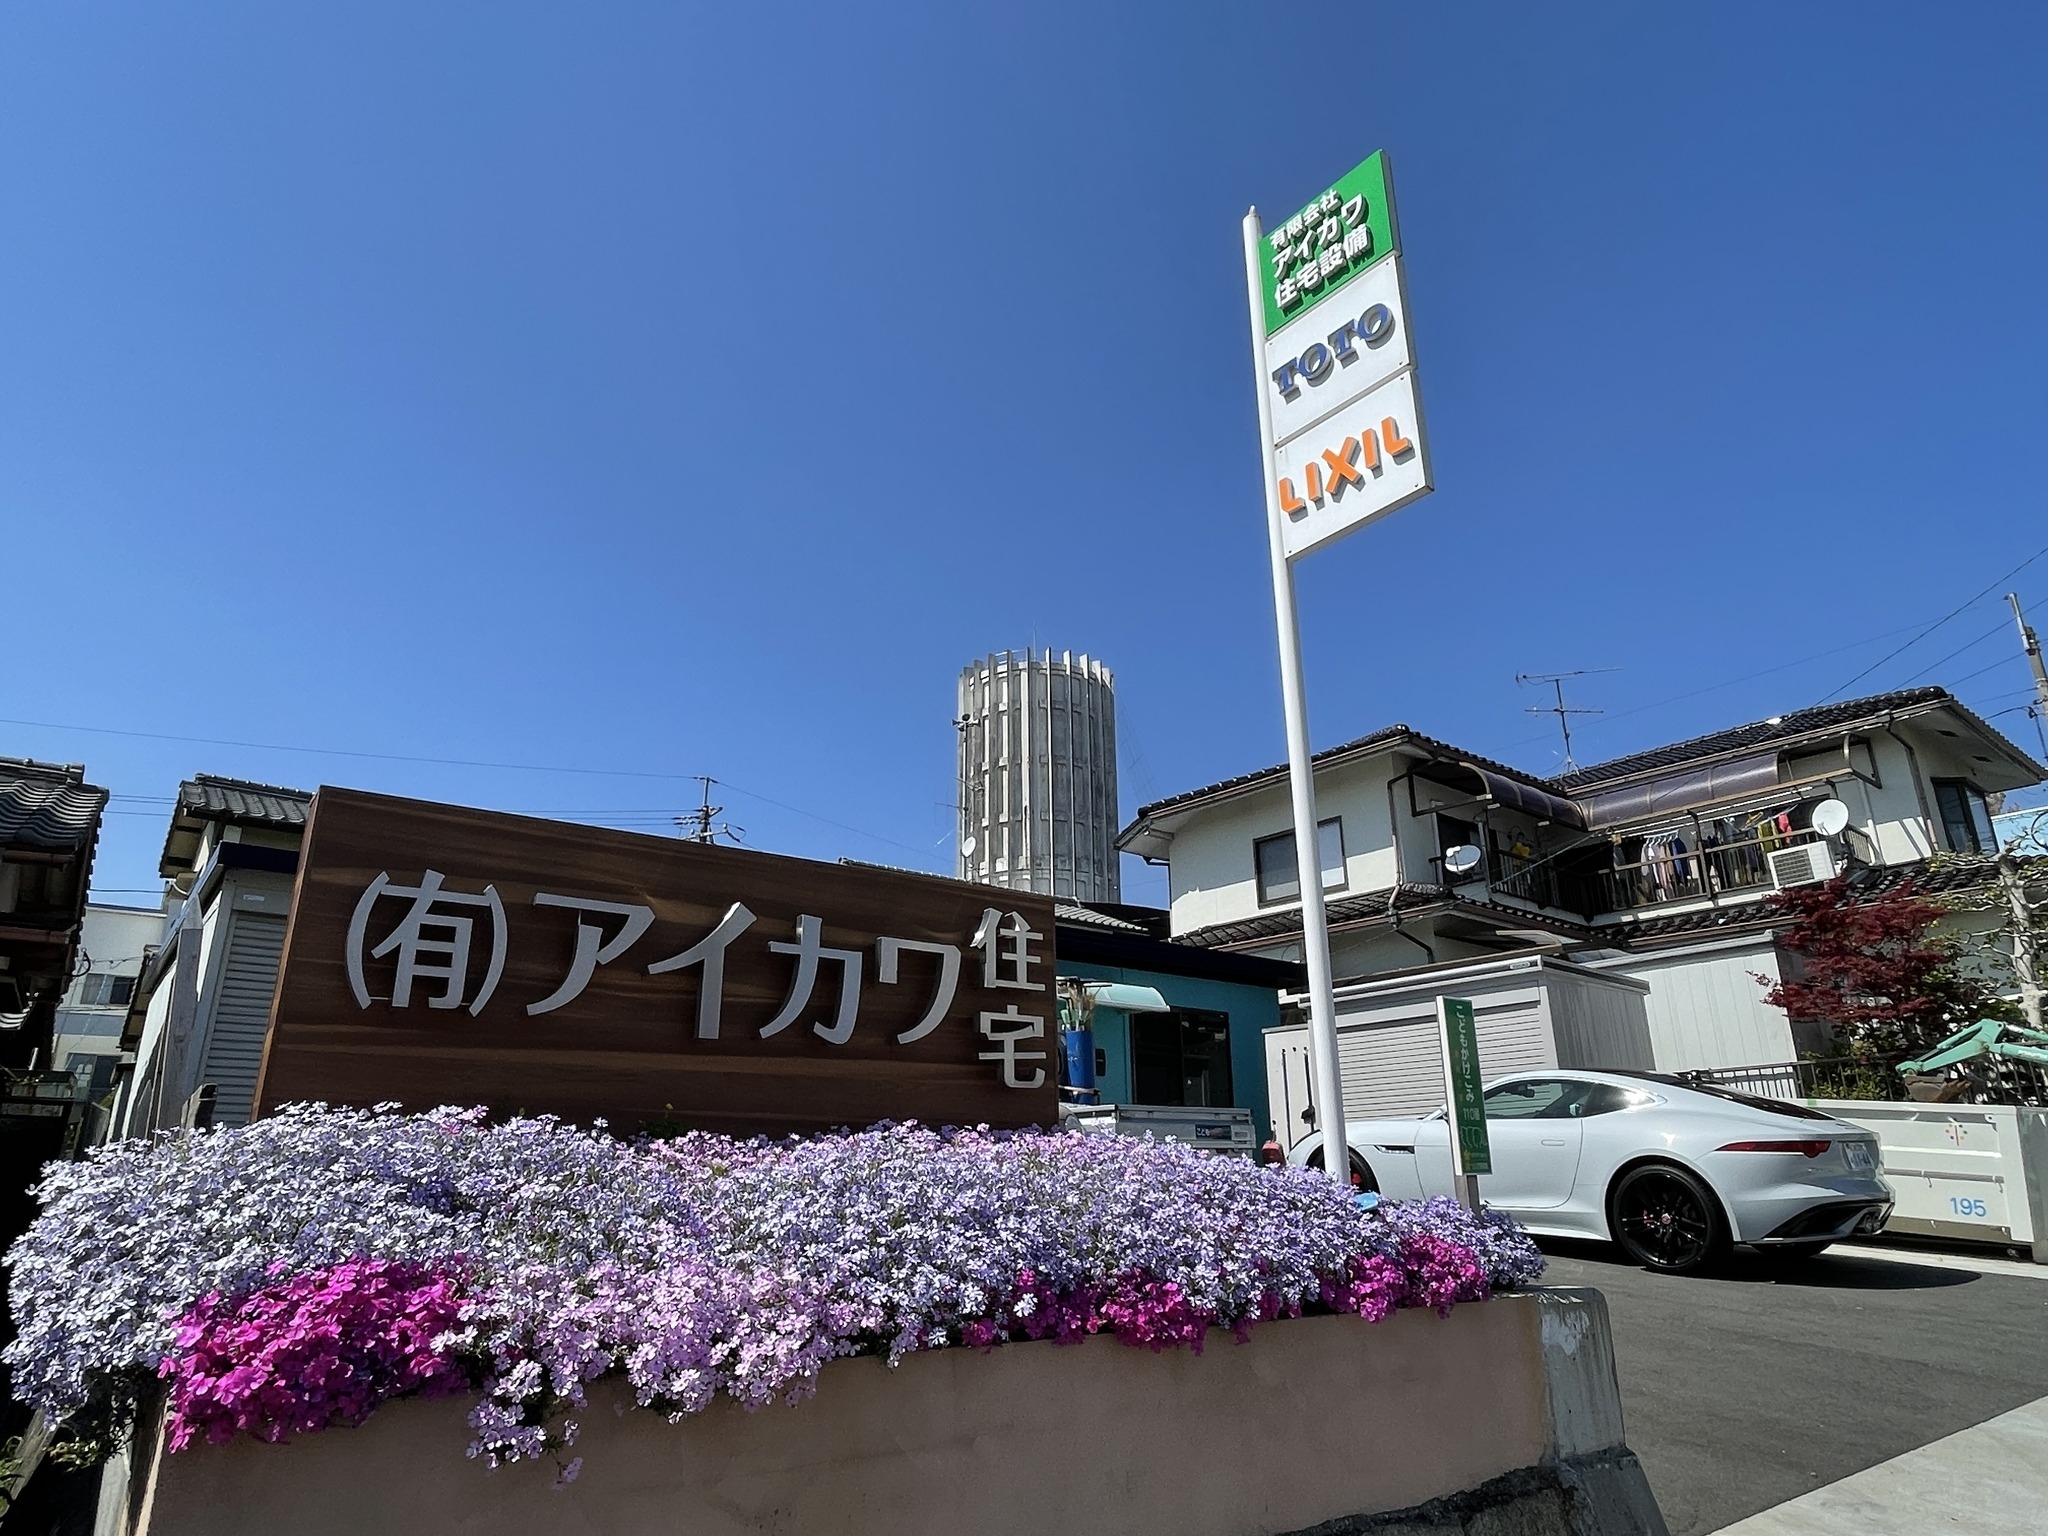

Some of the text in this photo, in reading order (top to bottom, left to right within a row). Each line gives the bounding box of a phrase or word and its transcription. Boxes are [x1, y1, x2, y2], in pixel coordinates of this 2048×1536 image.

[1270, 189, 1341, 250] 有限会社
[1271, 194, 1367, 279] アイカワ
[1274, 223, 1370, 309] 住宅設備
[1272, 303, 1396, 403] TOTO
[1279, 416, 1413, 519] LIXIL
[1950, 1197, 1986, 1217] 195
